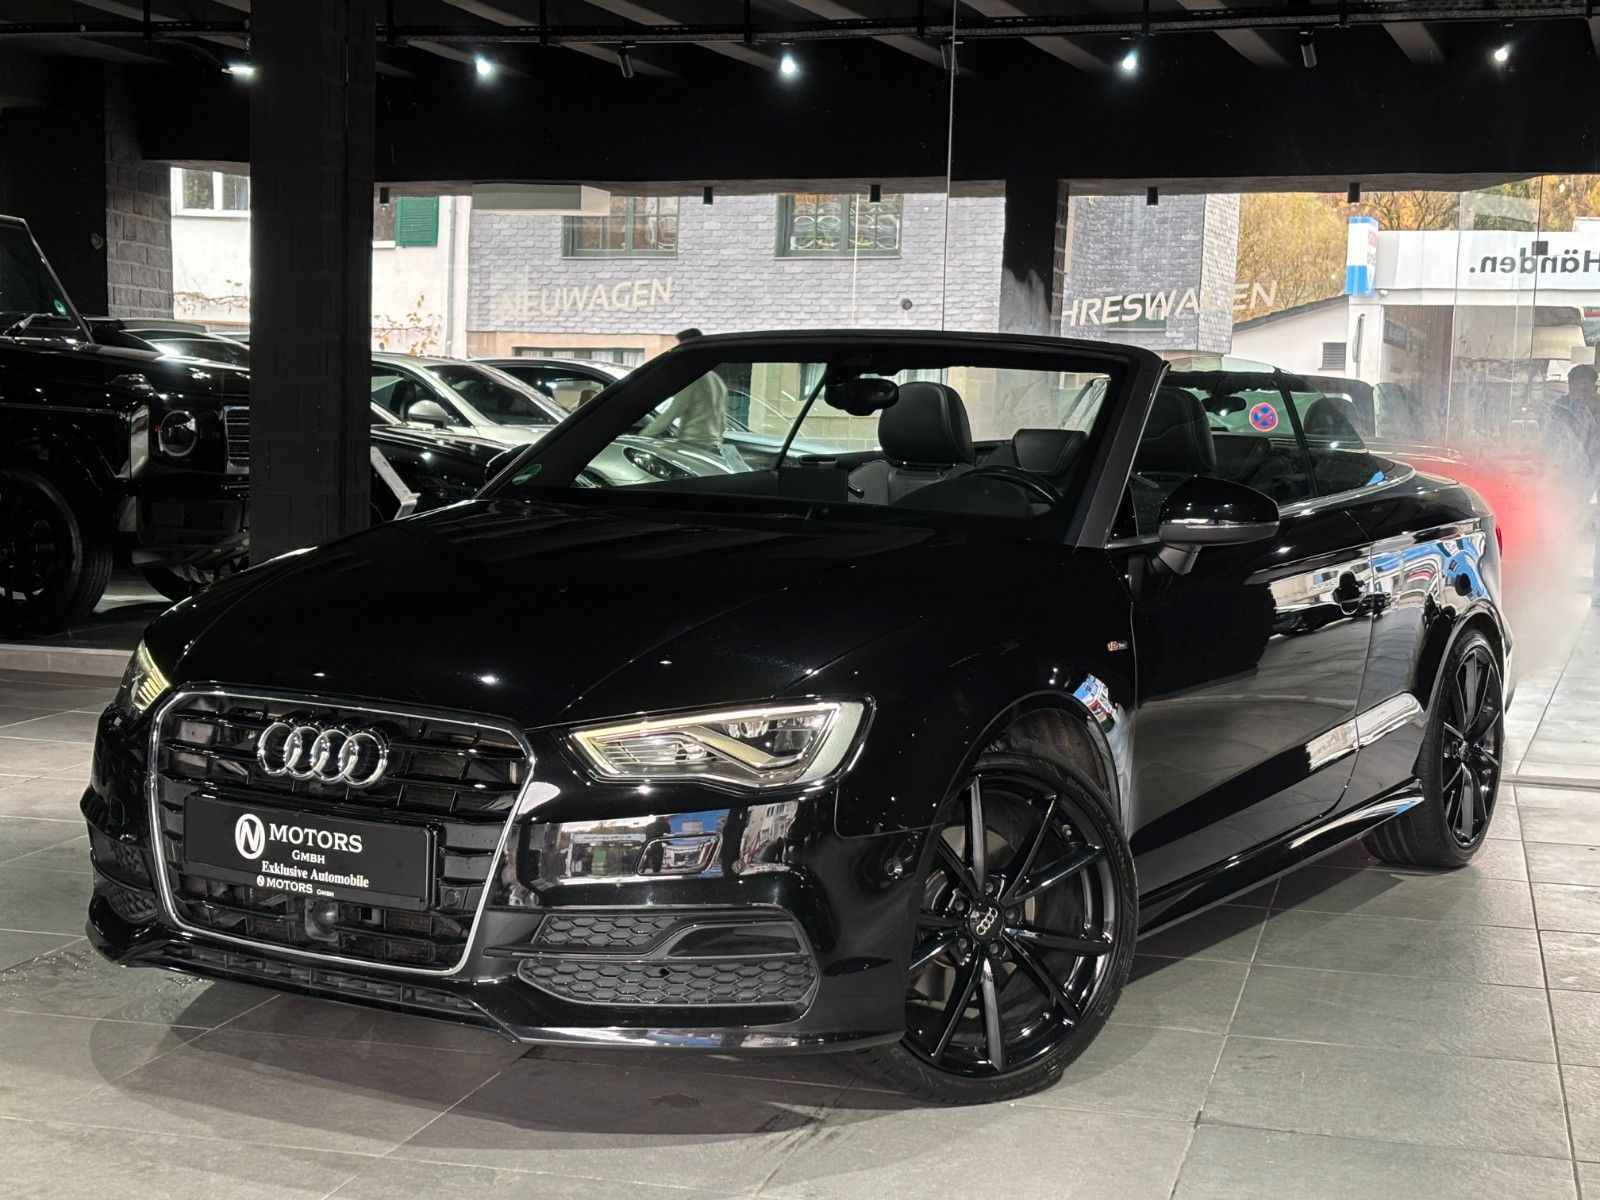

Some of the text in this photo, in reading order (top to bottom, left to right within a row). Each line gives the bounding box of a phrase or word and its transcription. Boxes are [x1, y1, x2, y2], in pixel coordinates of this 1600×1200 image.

[500, 276, 674, 318] NEUWAGEN
[269, 823, 363, 853] MOTORS
[262, 860, 370, 888] Exklusive Automobile
[266, 878, 313, 894] MOTORS
